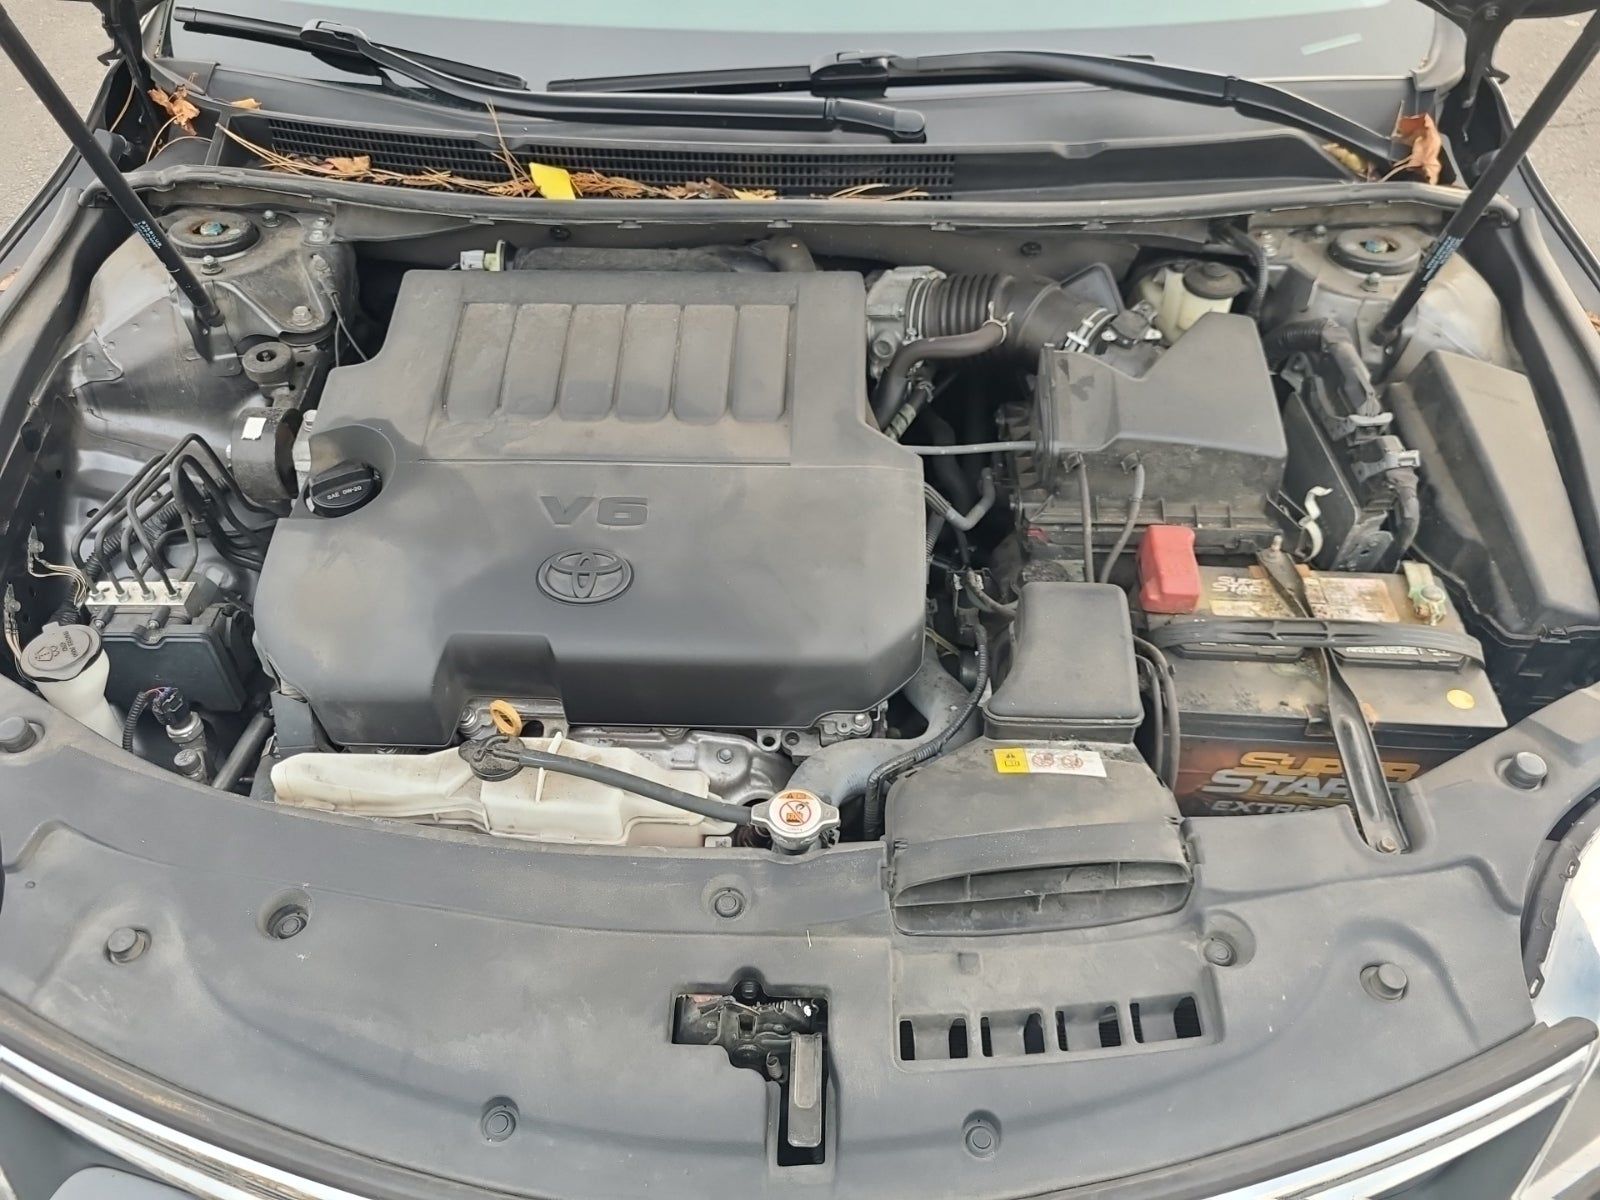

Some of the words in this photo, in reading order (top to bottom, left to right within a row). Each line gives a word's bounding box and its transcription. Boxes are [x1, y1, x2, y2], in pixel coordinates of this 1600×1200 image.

[327, 492, 340, 500] SAE
[539, 496, 648, 526] V6
[1240, 752, 1420, 783] SUPR
